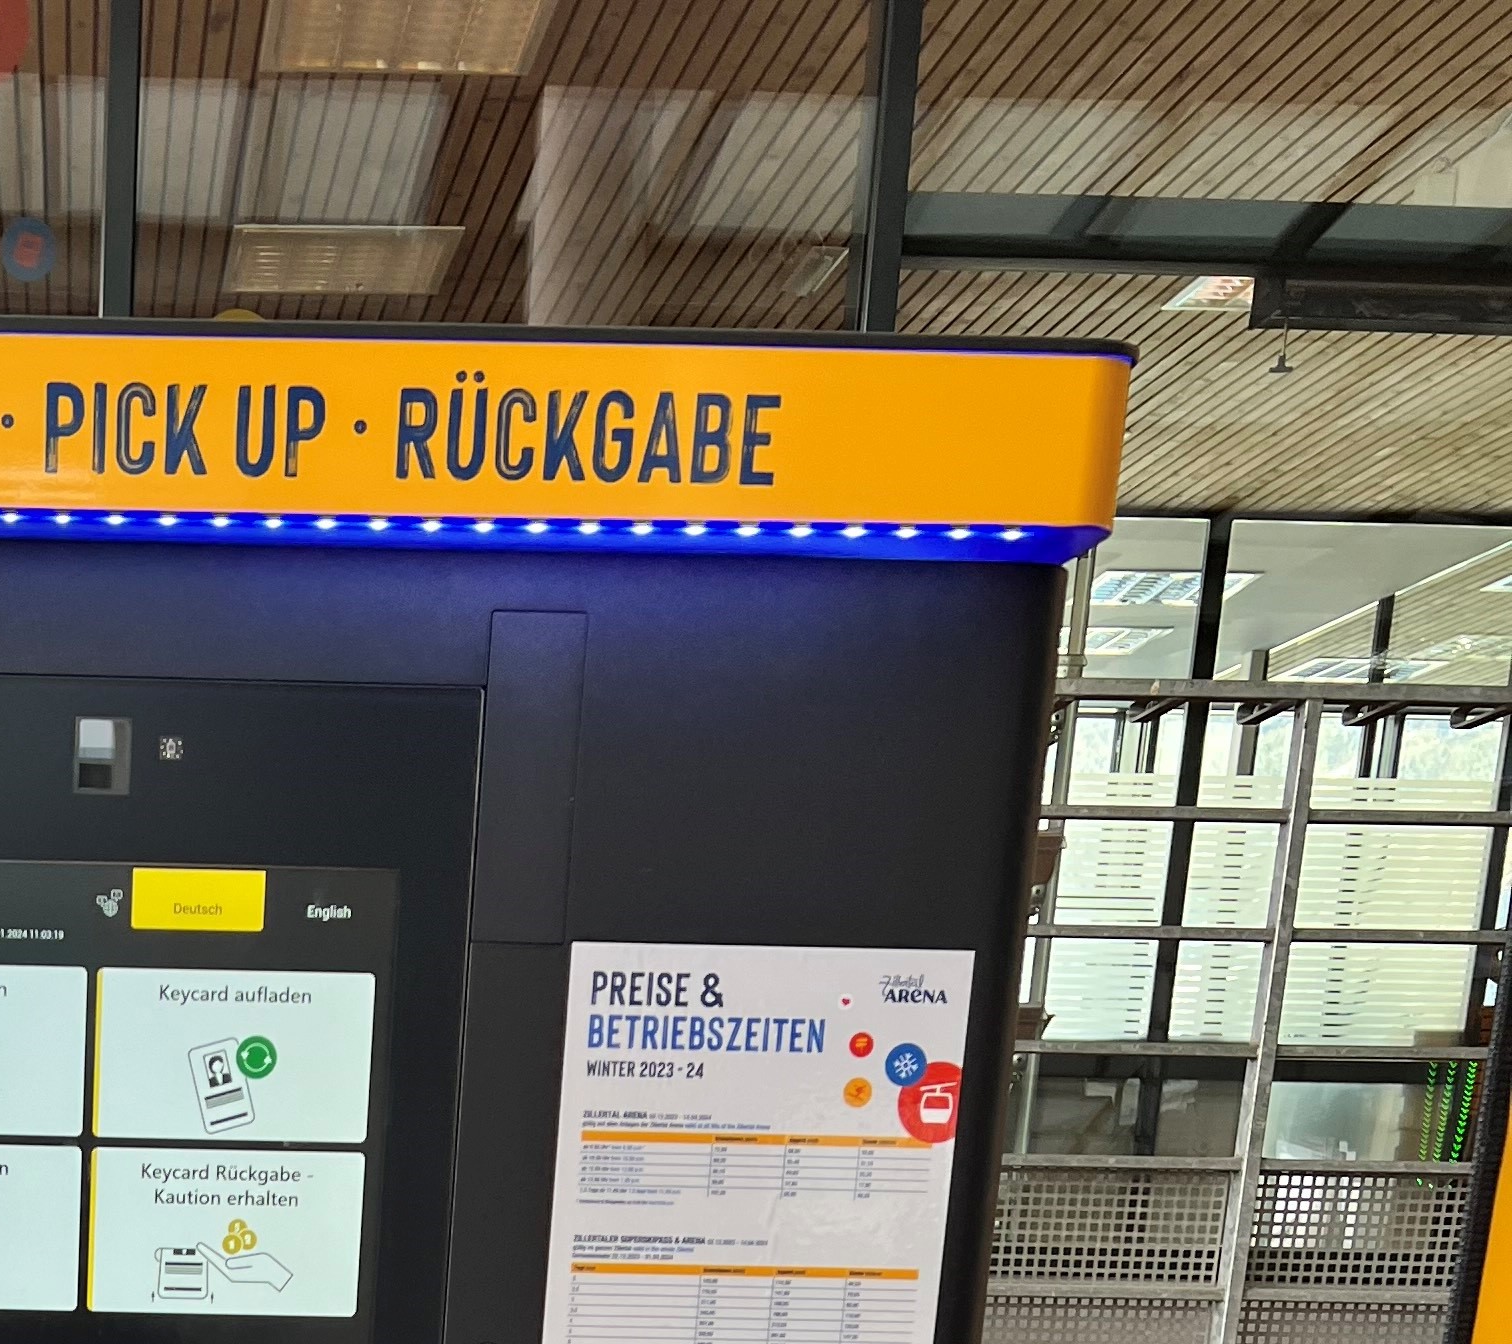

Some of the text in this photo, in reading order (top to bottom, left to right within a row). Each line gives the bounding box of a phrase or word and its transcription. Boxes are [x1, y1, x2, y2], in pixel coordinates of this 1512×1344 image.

[43, 378, 210, 476] PICK
[234, 382, 328, 480] UP
[393, 368, 786, 488] RÜCKGABE
[173, 902, 352, 922] Deutsch English
[158, 983, 312, 1006] Keycard aufladen
[590, 970, 725, 1009] PREISE &
[587, 1012, 828, 1055] BETRIEBSZEITEN
[586, 1059, 636, 1079] WINTER
[639, 1062, 674, 1080] 2023
[685, 1063, 705, 1081] 24
[140, 1162, 210, 1184] Keycard
[216, 1163, 302, 1187] Rückgabe
[153, 1188, 299, 1208] Kaution erhalten
